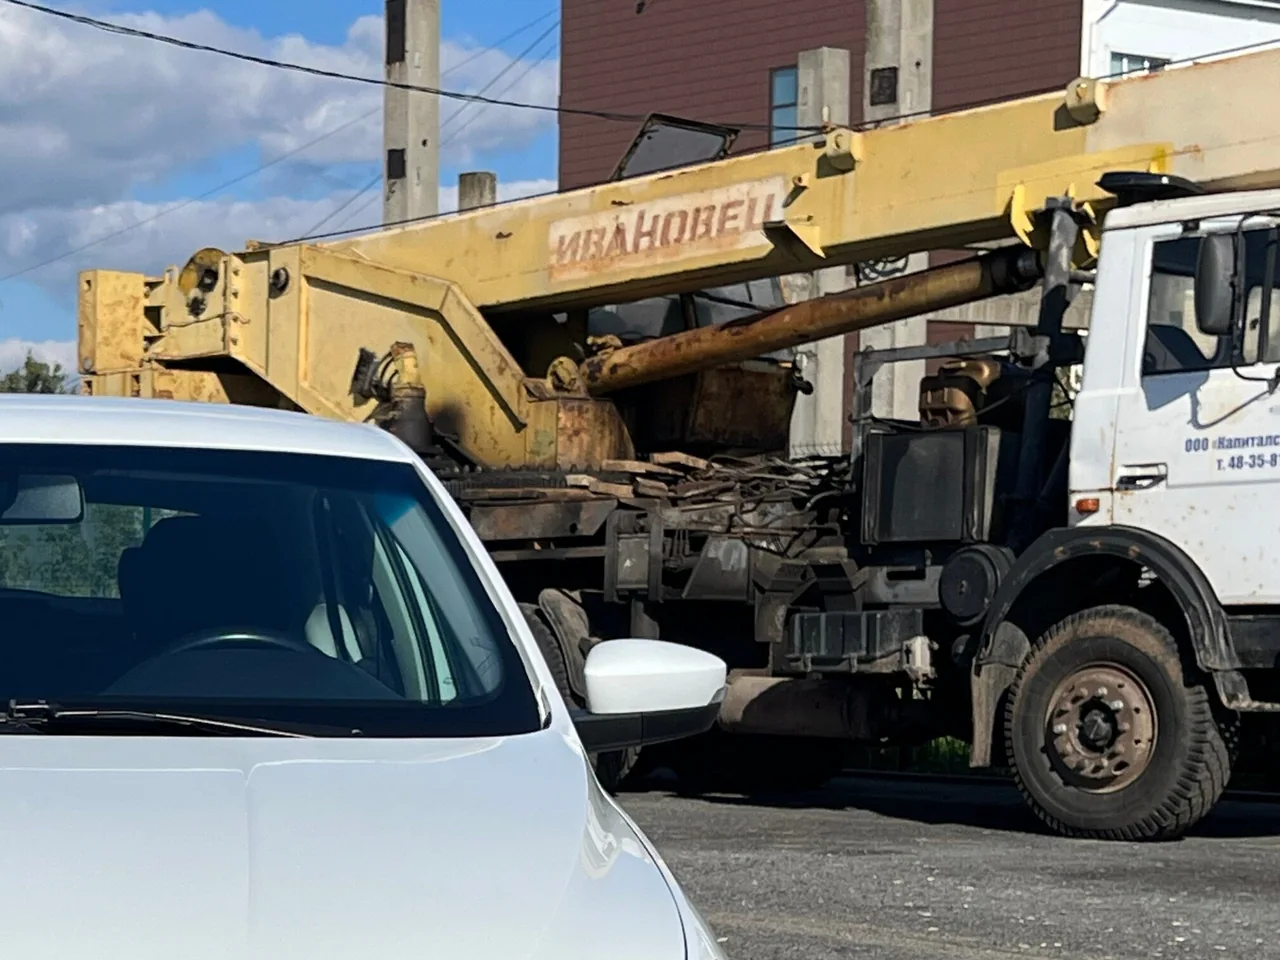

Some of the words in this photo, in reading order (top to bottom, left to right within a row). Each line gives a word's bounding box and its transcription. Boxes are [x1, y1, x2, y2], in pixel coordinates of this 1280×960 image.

[554, 193, 775, 263] ИВАНОВЕЦ
[1185, 437, 1209, 452] ООО
[1227, 453, 1280, 470] 48-35-8
